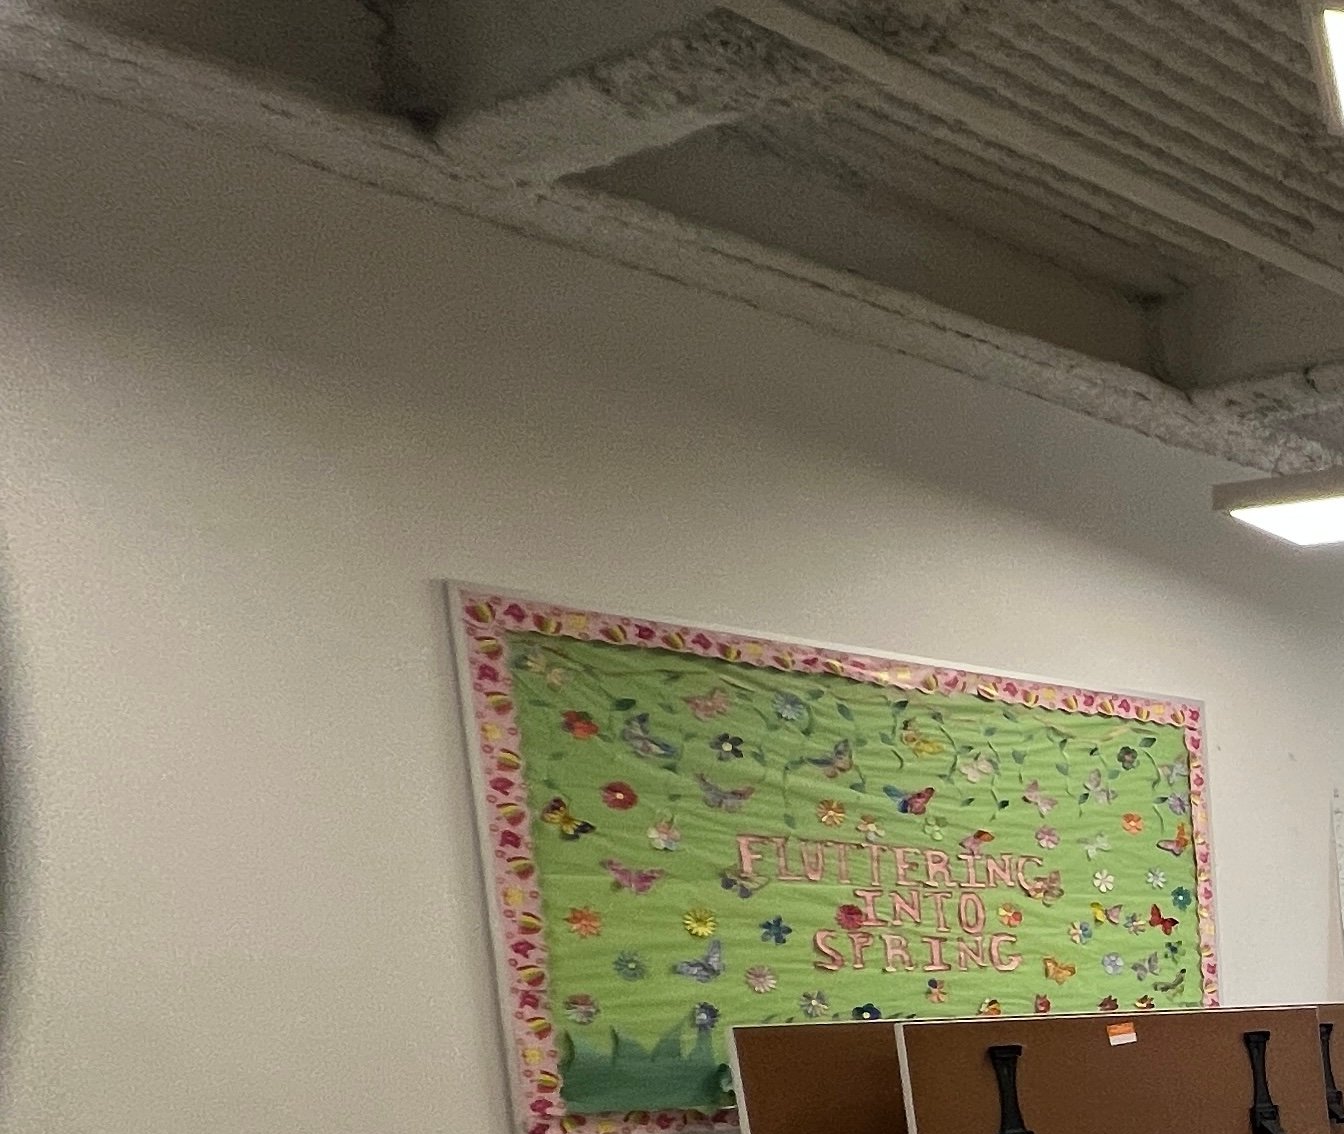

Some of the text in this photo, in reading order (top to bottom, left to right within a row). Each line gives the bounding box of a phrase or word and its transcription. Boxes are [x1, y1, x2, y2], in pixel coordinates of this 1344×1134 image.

[737, 834, 1043, 892] FLUTTERING
[855, 888, 986, 934] INTO
[813, 929, 1022, 973] SPRING
